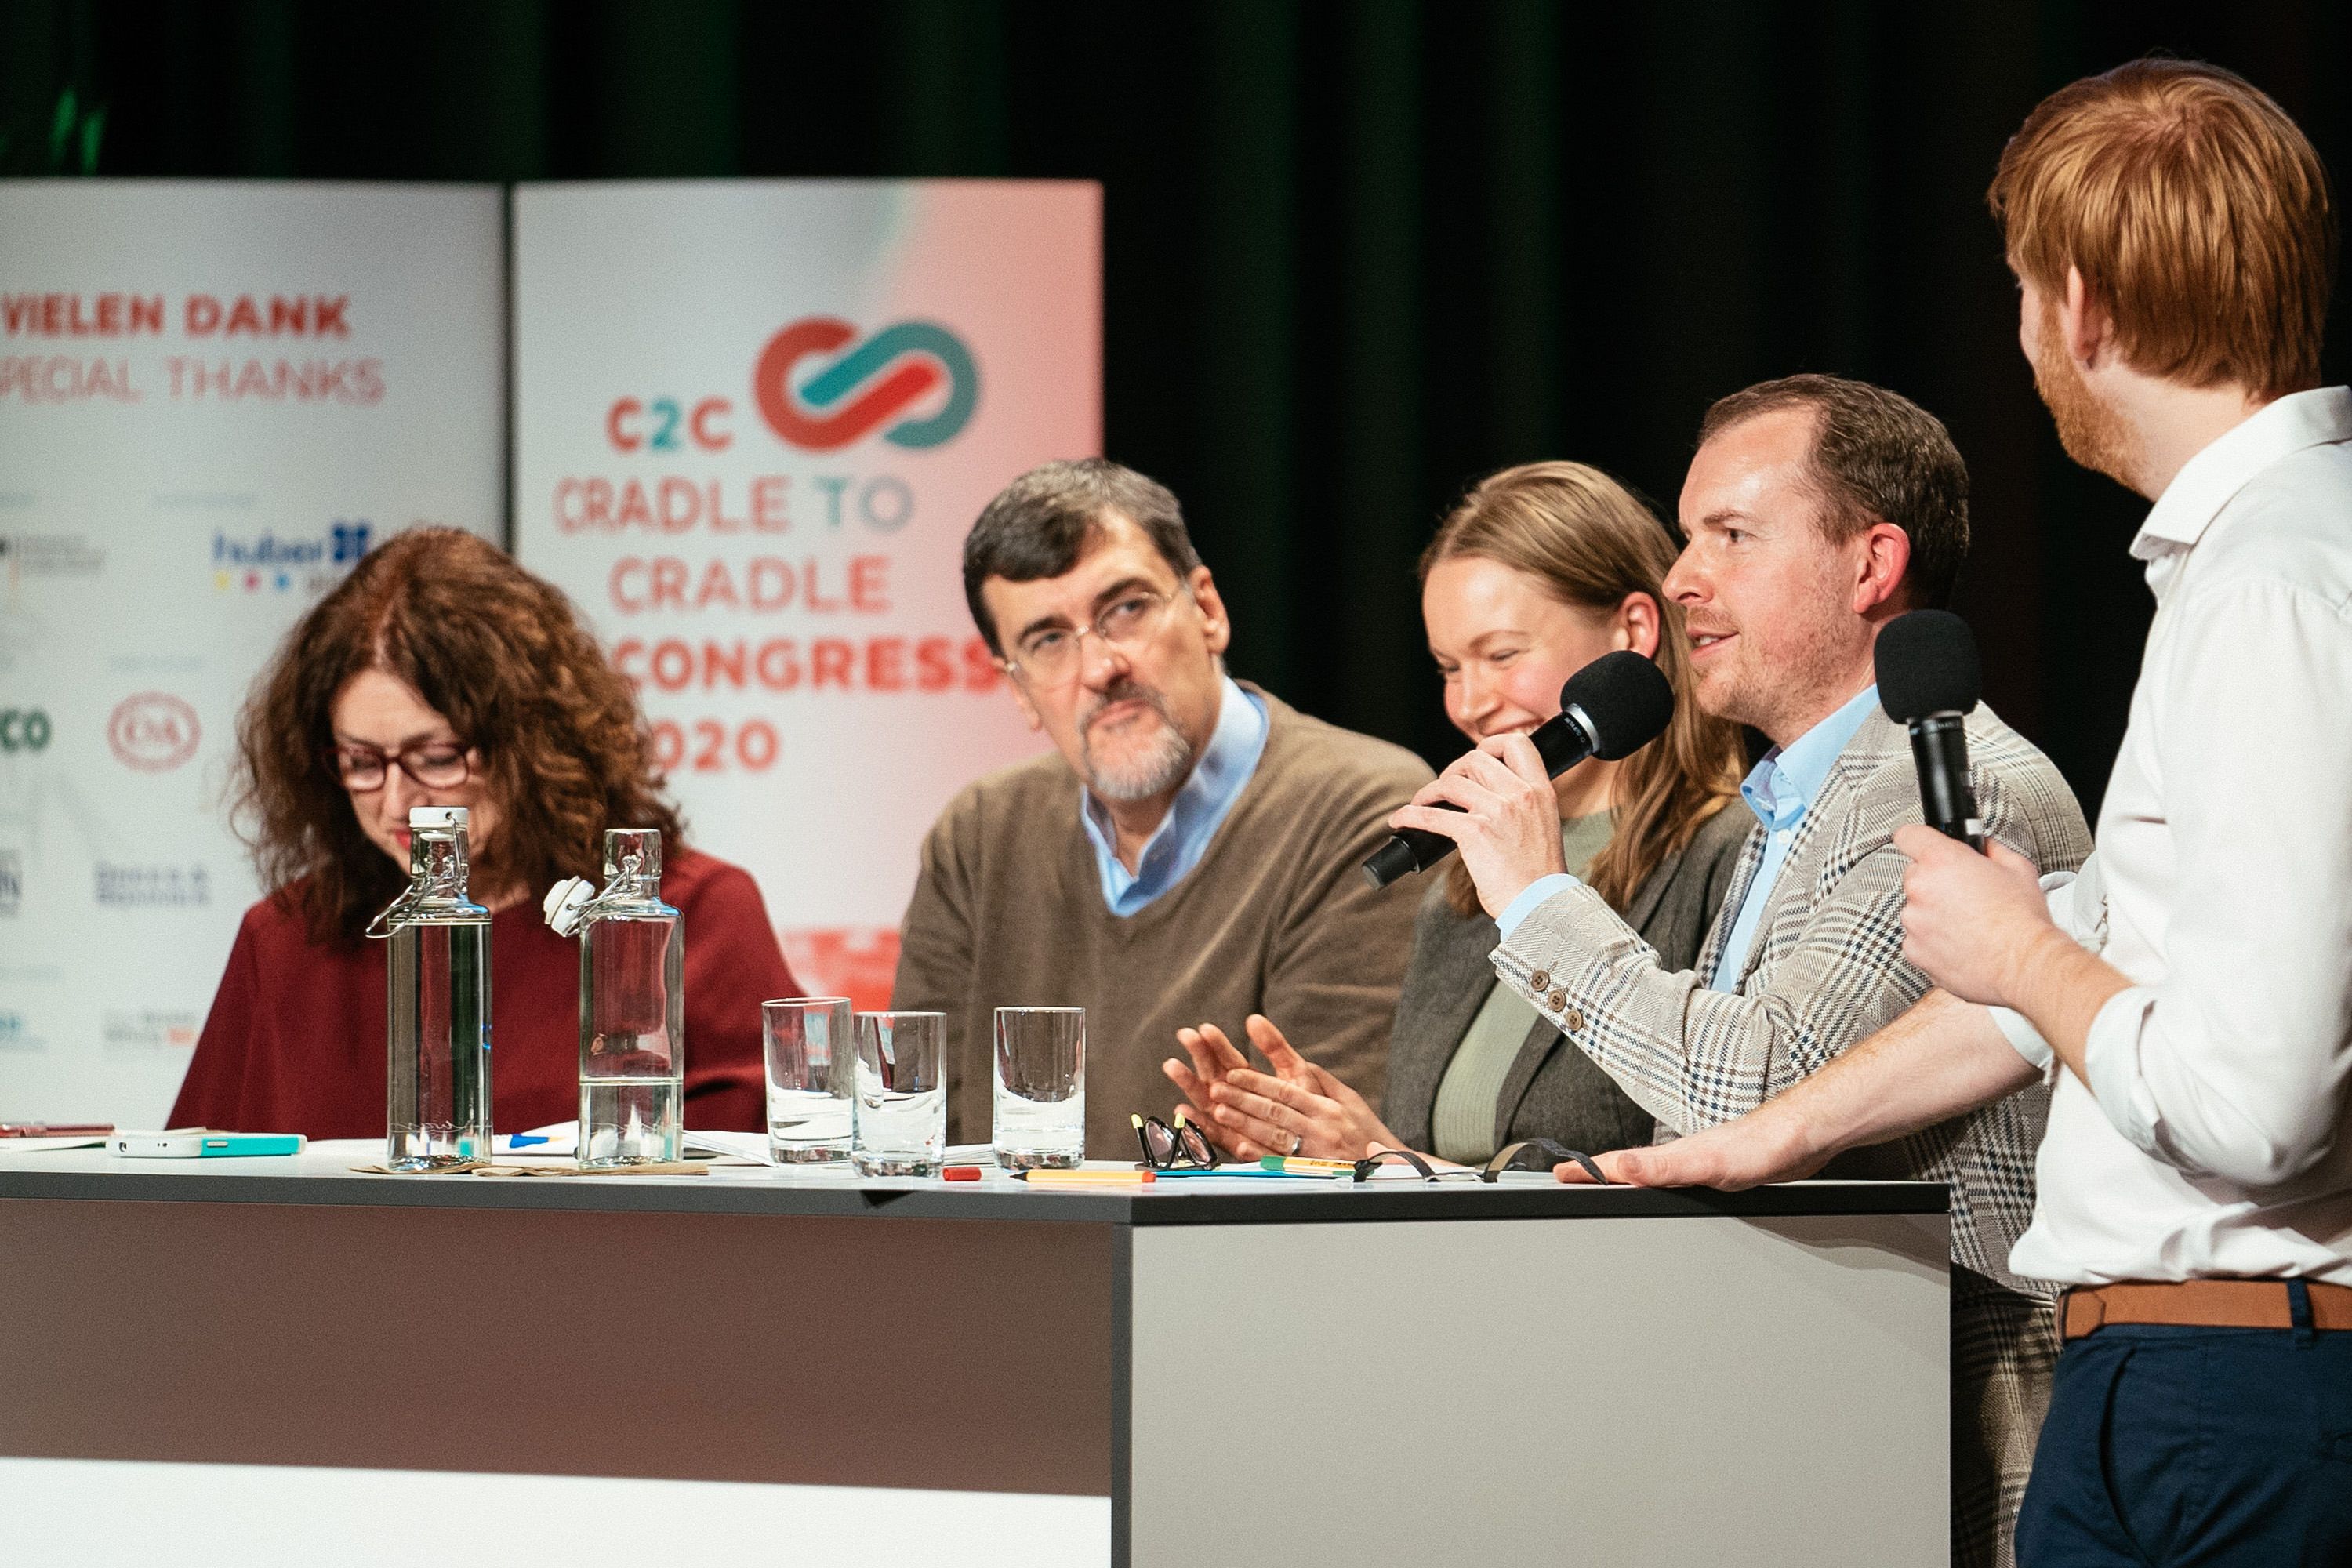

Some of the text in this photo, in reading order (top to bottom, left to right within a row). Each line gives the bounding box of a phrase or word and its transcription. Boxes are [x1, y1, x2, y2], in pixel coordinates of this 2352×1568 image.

[183, 294, 352, 339] DANK
[0, 355, 387, 405] PECIAL THANKS
[606, 394, 734, 452] C2C
[554, 473, 916, 535] CRADLE TO
[608, 556, 891, 614] CRADLE
[648, 719, 780, 771] 020
